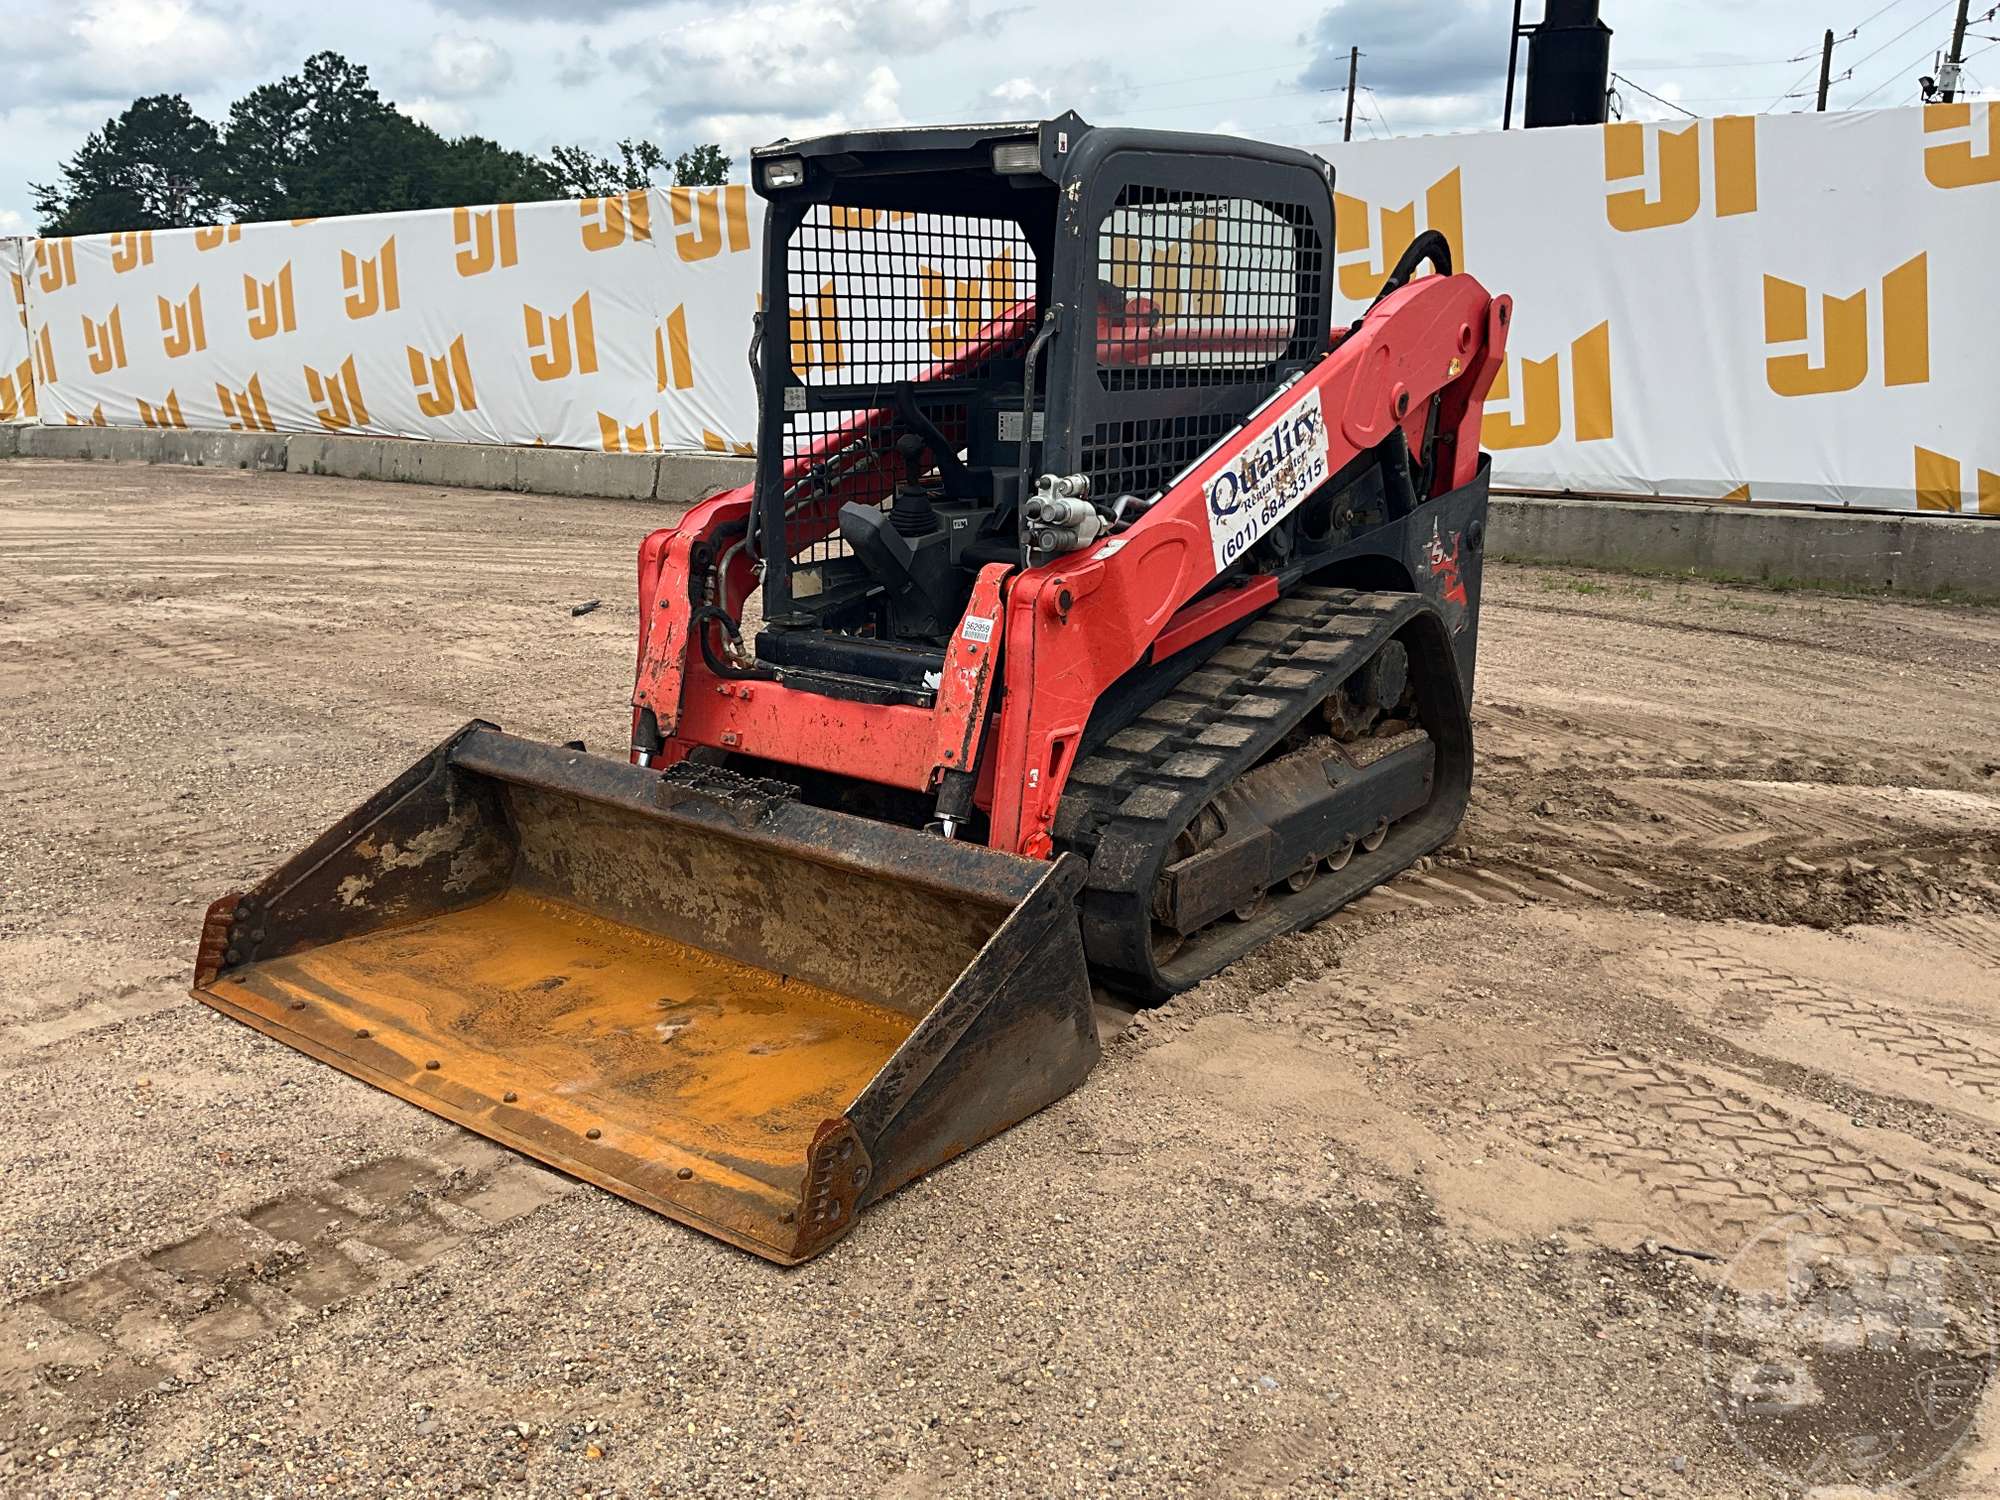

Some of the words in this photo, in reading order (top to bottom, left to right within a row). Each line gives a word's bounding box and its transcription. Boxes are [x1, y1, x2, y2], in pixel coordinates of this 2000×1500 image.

[1210, 406, 1318, 525] Quality
[1222, 518, 1258, 566] (601)
[1261, 458, 1322, 526] 684-3315
[1241, 477, 1274, 512] Rental
